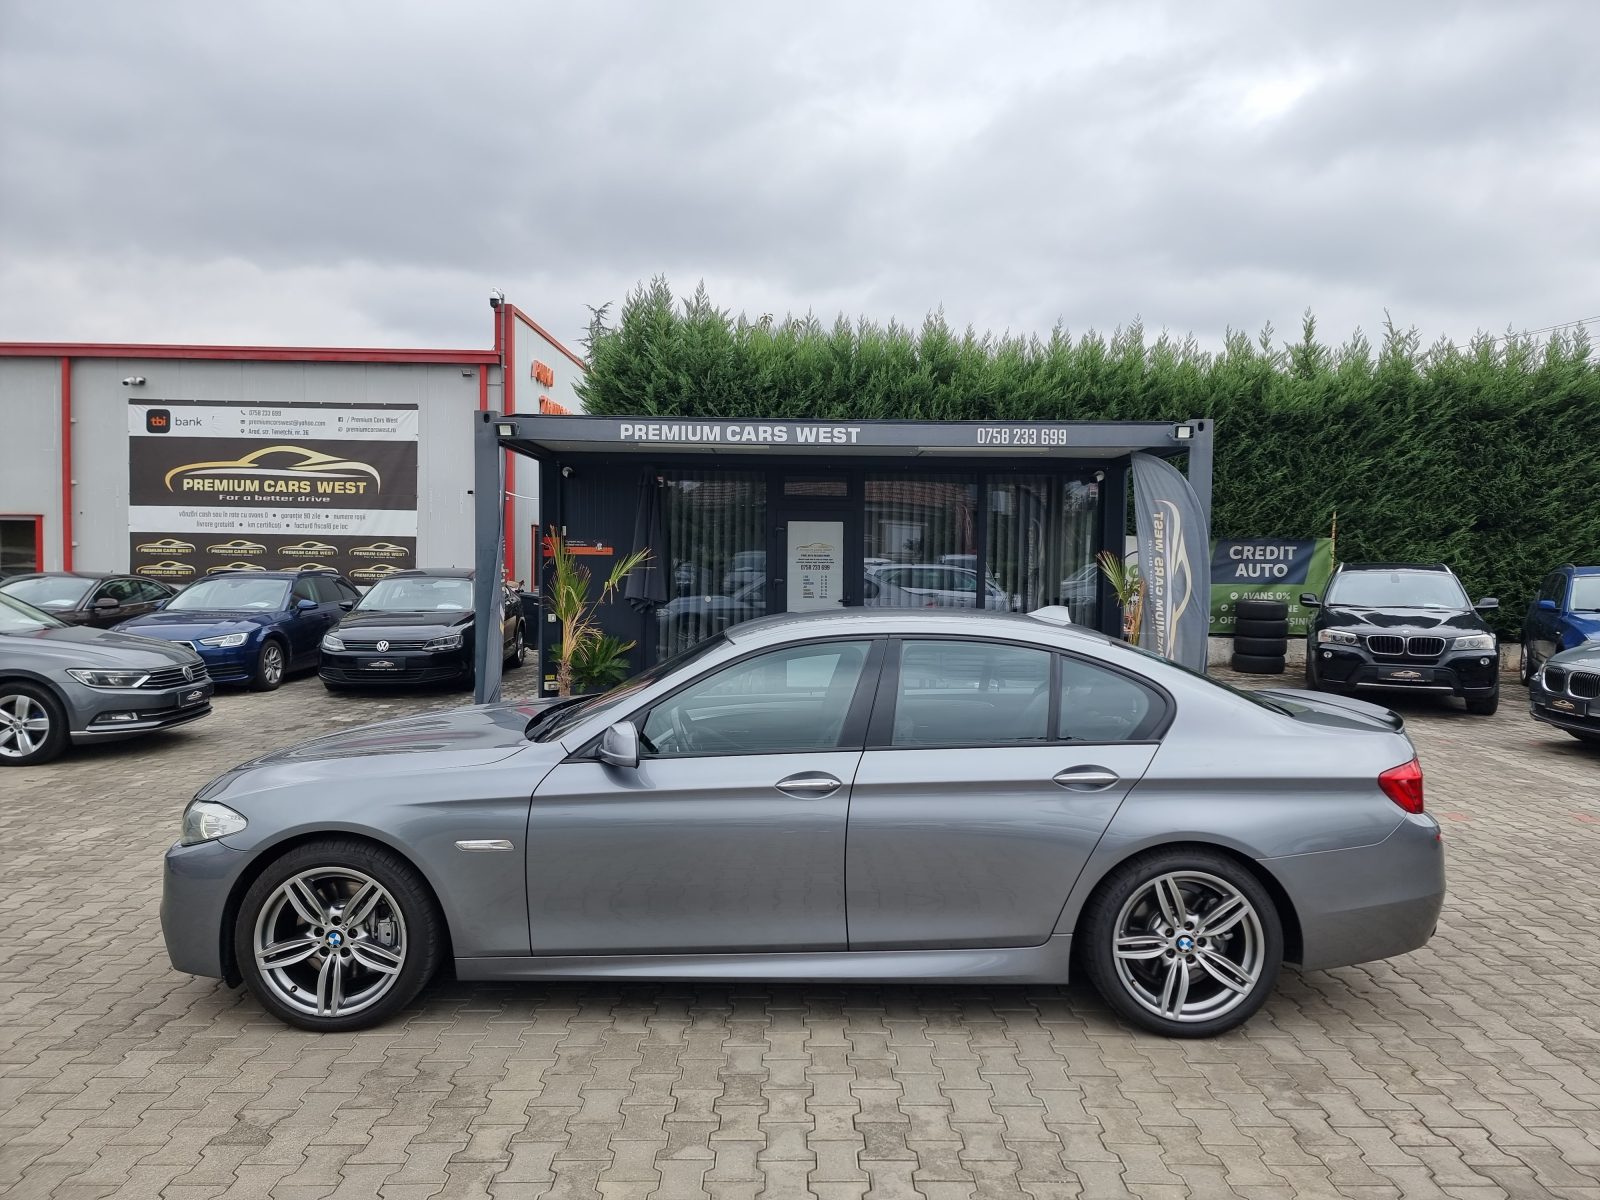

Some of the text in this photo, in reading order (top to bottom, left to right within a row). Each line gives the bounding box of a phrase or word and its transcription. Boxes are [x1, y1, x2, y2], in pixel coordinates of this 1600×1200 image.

[151, 416, 202, 426] tbi bank
[620, 424, 860, 443] PREMIUM CARS WEST
[977, 428, 1066, 444] 0758 233 699
[183, 479, 367, 494] PREMIUM CARS WEST
[1230, 546, 1297, 560] CREDIT
[1235, 563, 1288, 578] AUTO
